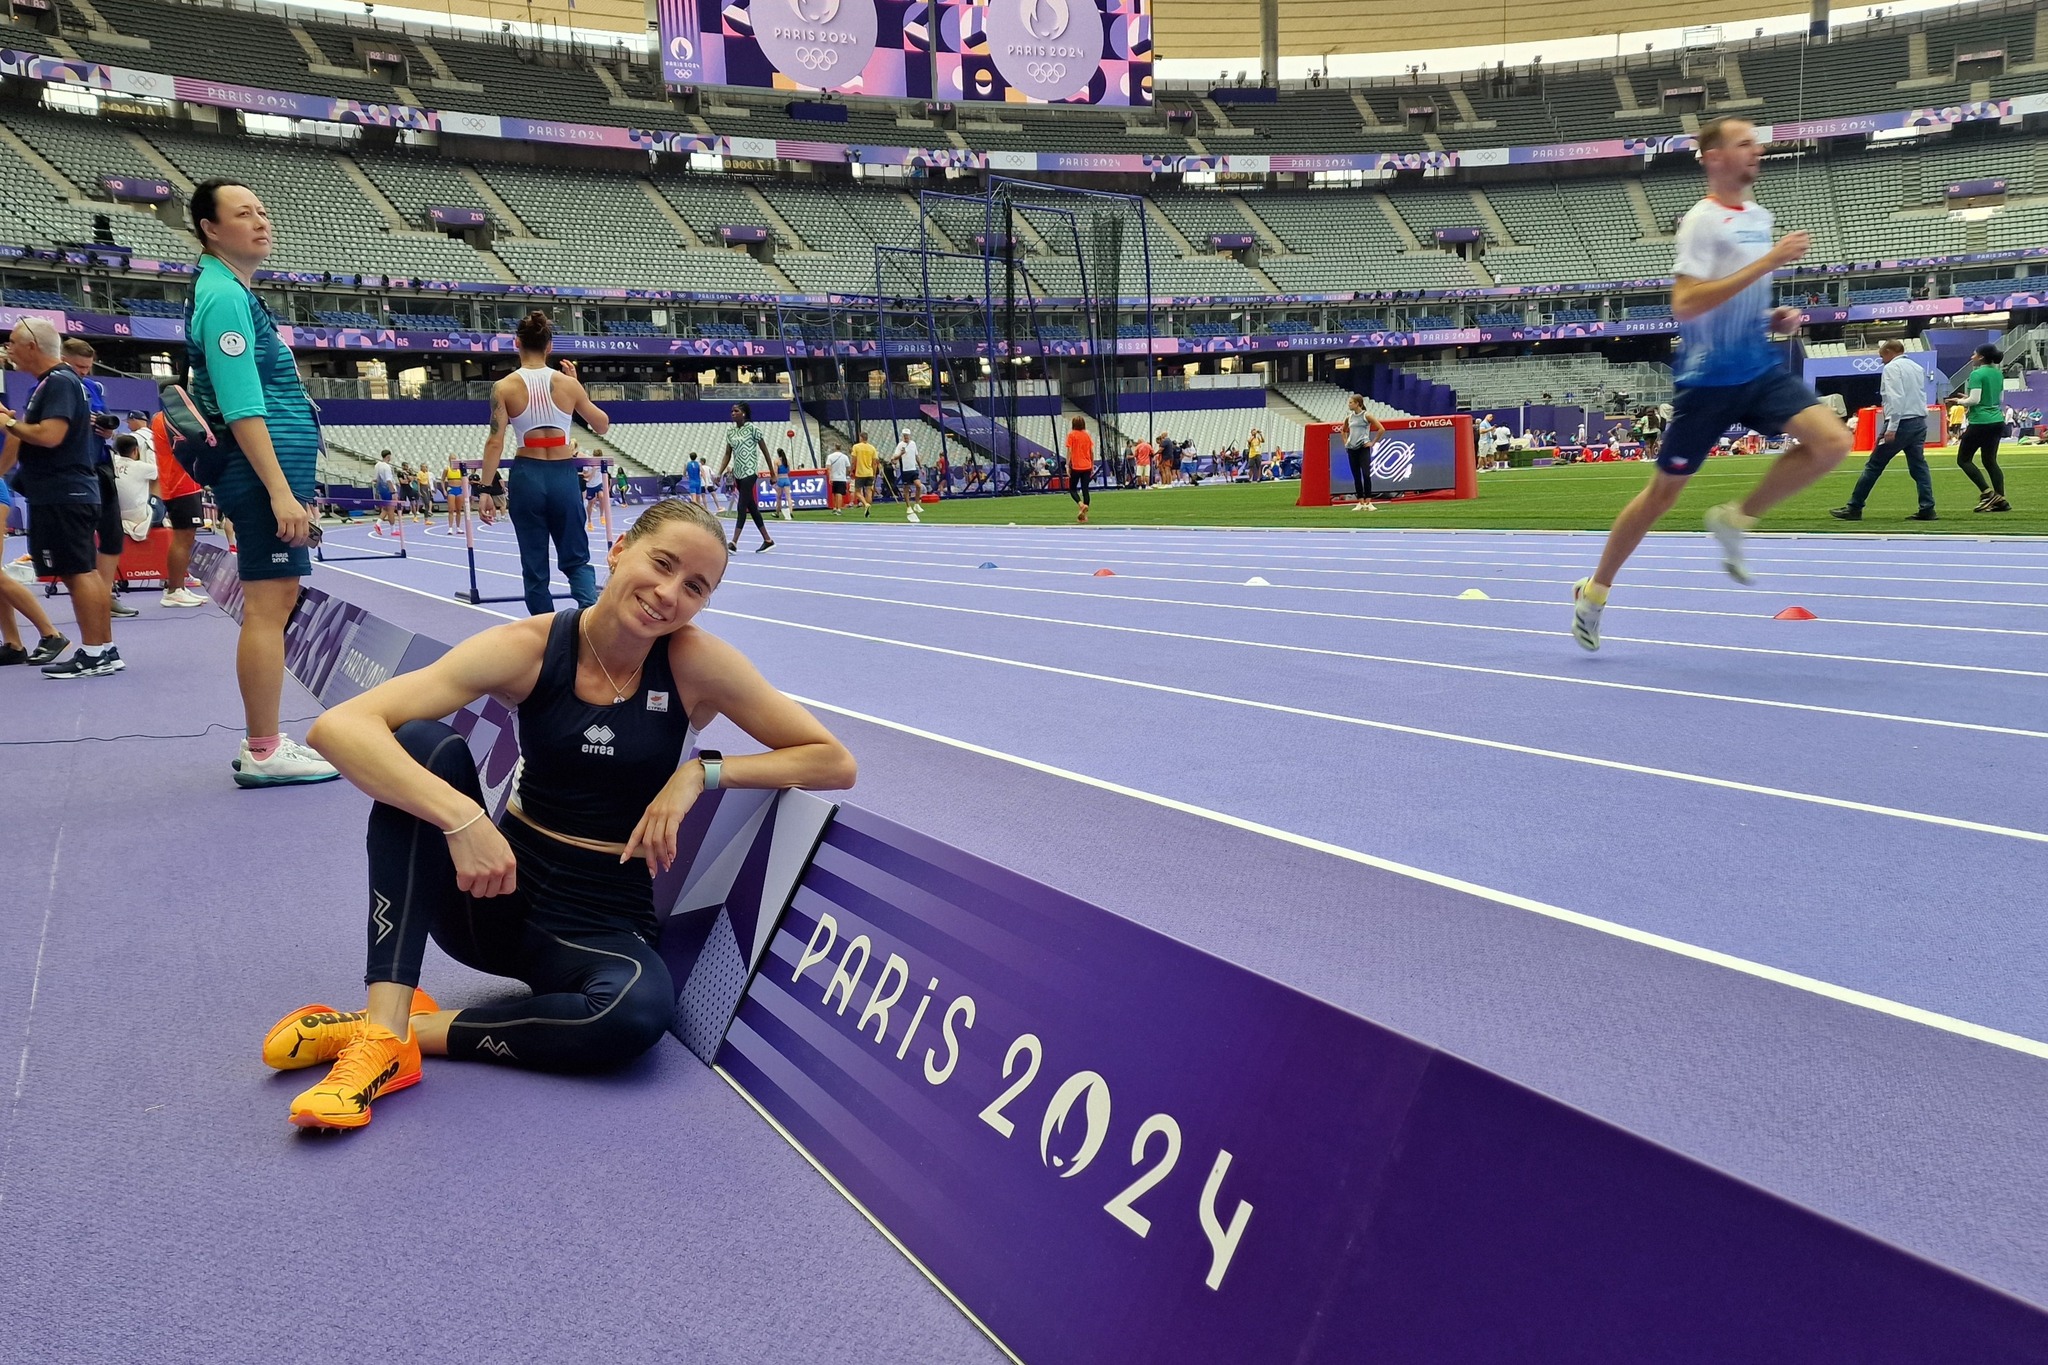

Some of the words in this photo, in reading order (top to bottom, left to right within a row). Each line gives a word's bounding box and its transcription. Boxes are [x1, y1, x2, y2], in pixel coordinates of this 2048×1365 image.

[774, 28, 815, 42] PARIS
[820, 31, 858, 45] 2024
[1008, 45, 1046, 58] PARIS
[1051, 46, 1085, 59] 2024
[207, 87, 252, 103] PARIS
[257, 94, 297, 109] 2024
[528, 125, 565, 138] PARIS
[570, 129, 603, 141] 2024
[1800, 124, 1836, 135] PARIS
[1841, 120, 1875, 131] 2024
[1532, 149, 1564, 158] PARIS
[1569, 146, 1599, 155] 2024
[1059, 158, 1089, 167] PARIS
[1093, 158, 1121, 167] 2024
[1291, 159, 1321, 168] PARIS
[1325, 159, 1353, 168] 2024
[1872, 305, 1904, 315] PARIS
[1909, 303, 1939, 313] 2024
[68, 319, 83, 332] B5
[1659, 321, 1679, 329] 202
[1292, 338, 1318, 346] PARIS
[1320, 337, 1343, 345] 2024
[1423, 333, 1449, 341] PARIS
[1452, 332, 1476, 340] 2024
[575, 340, 606, 350] PARIS
[611, 341, 639, 350] 2024
[898, 344, 925, 353] PARIS
[1106, 342, 1133, 350] PRIS
[1135, 342, 1159, 350] 204
[1420, 419, 1453, 427] OMEGA
[581, 743, 615, 756] errea
[978, 1033, 1254, 1291] 2024
